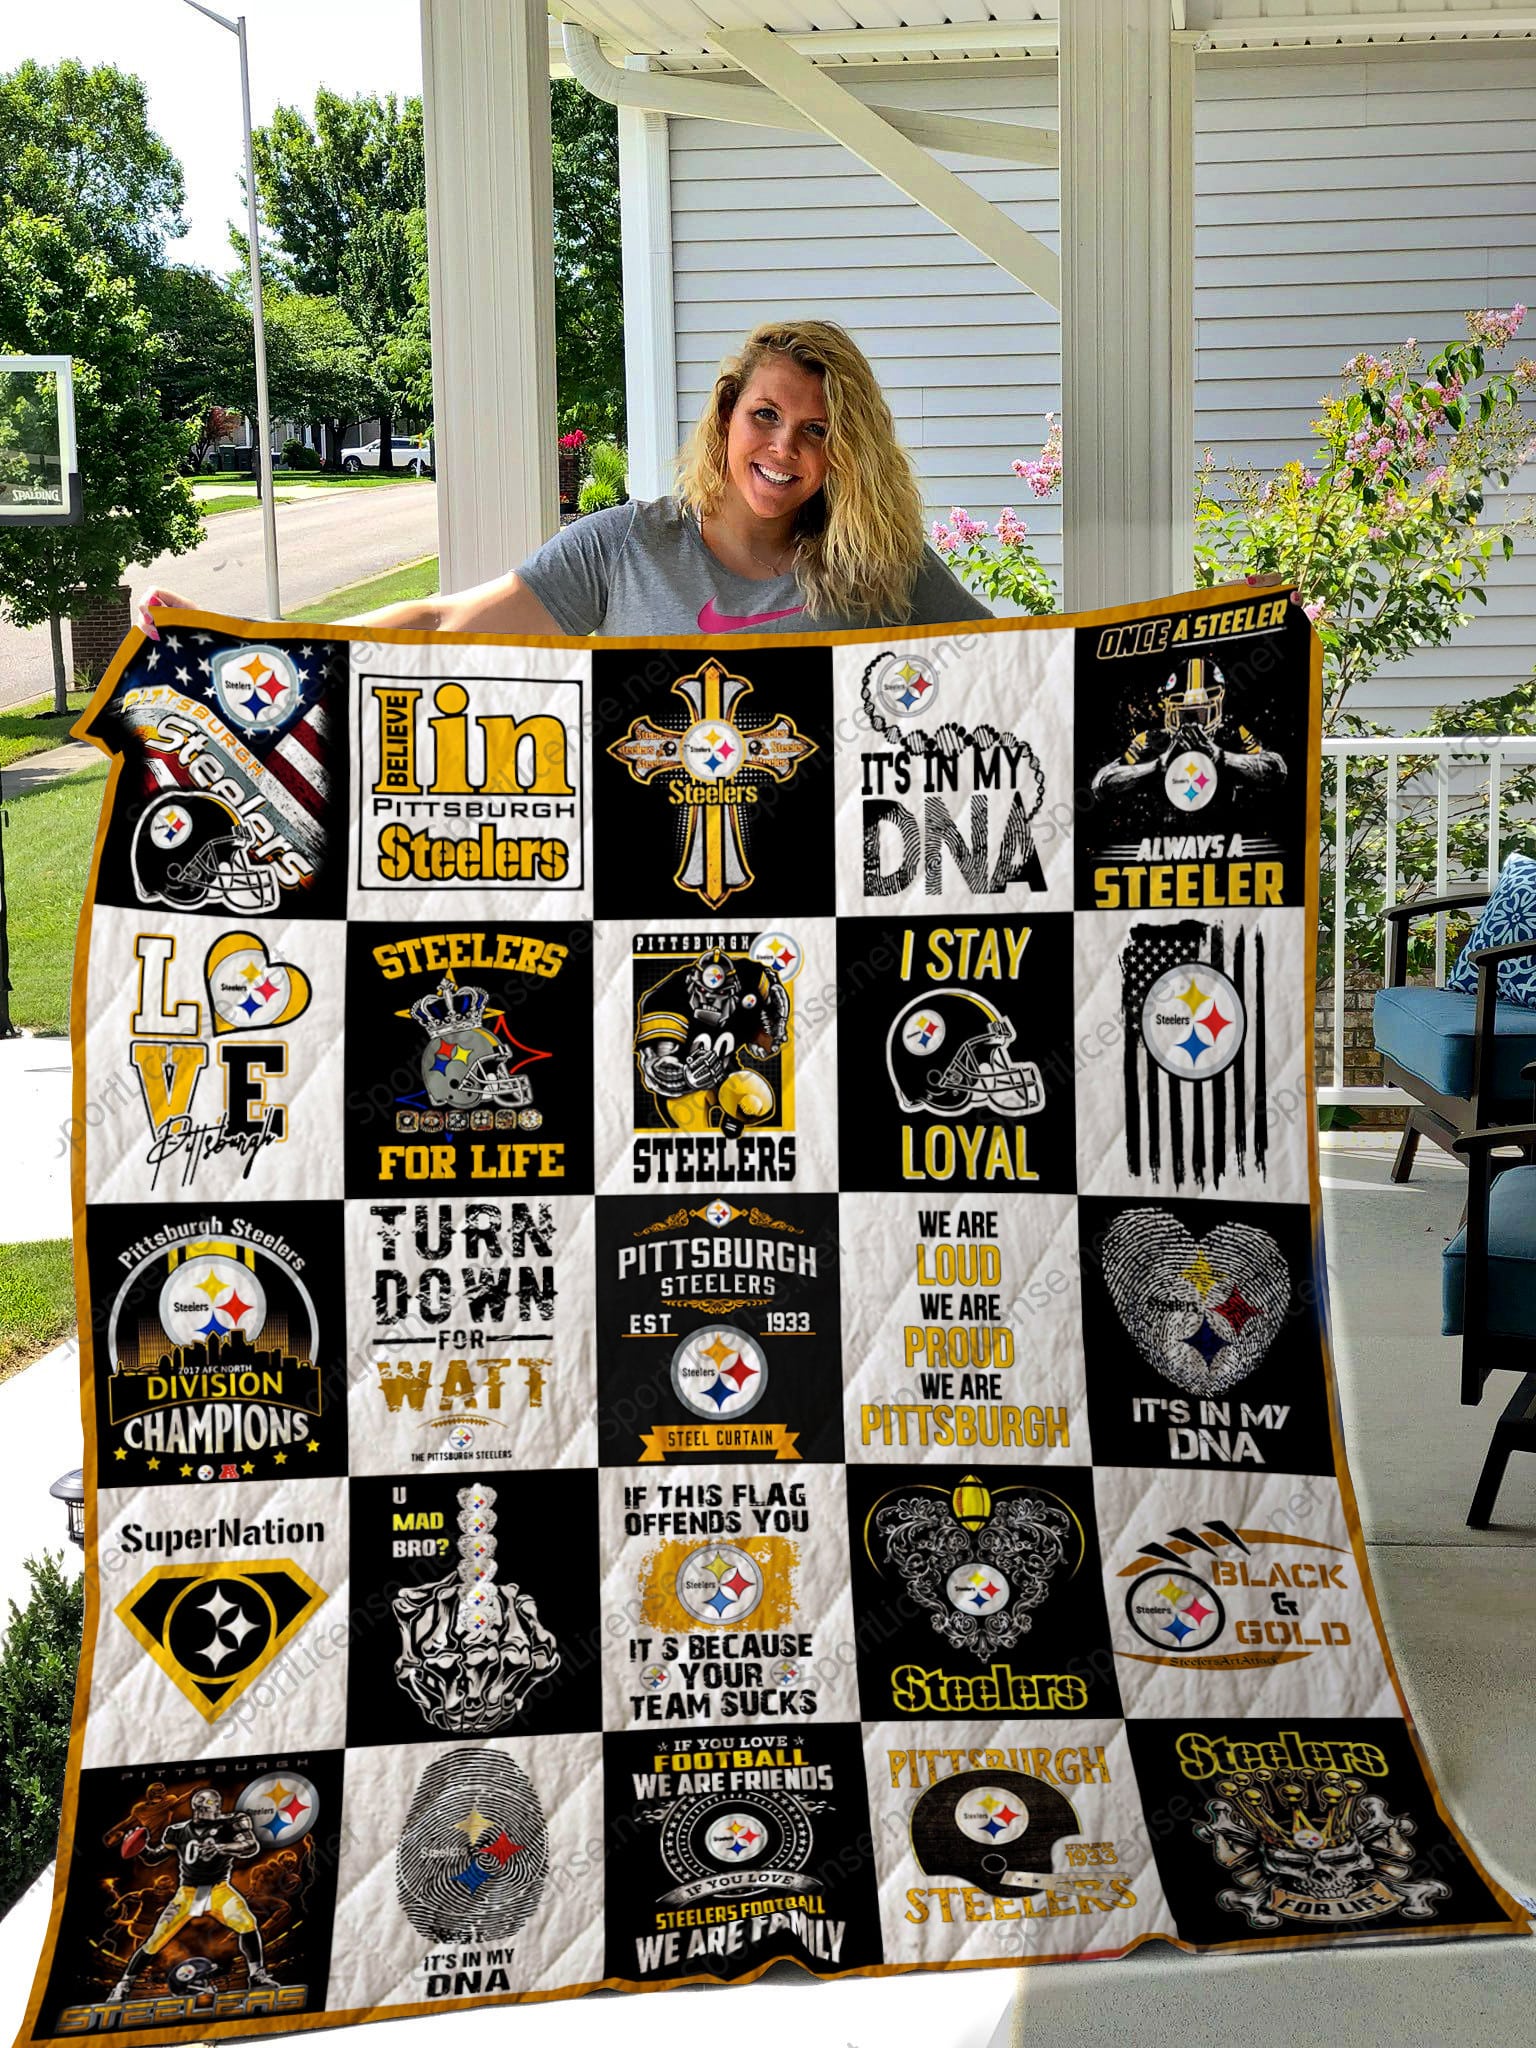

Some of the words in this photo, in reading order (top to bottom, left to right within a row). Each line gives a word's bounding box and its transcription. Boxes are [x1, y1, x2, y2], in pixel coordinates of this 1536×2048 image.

[12, 489, 61, 503] SPALDING
[1096, 618, 1171, 660] ONCE
[1172, 616, 1188, 642] A
[1194, 598, 1289, 639] STEELER
[223, 679, 253, 691] Steelers
[121, 685, 265, 778] PITTSBURGH
[386, 695, 408, 787] BELIEVE
[427, 682, 576, 796] in
[924, 749, 958, 793] IN
[973, 745, 1024, 791] MY
[145, 714, 315, 888] Steelers
[668, 776, 758, 805] Steelers
[373, 797, 575, 818] PITTSBURGH
[378, 822, 569, 881] Steelers
[862, 791, 1048, 897] DNA
[1136, 835, 1226, 861] ALWAYS
[1225, 833, 1245, 858] A
[1094, 861, 1284, 908] STEELER
[372, 932, 569, 980] STEELERS
[636, 935, 750, 951] PITTSBURGH
[900, 929, 915, 981] I
[926, 926, 1032, 981] STAY
[221, 983, 248, 992] Steelers
[1156, 1013, 1191, 1026] Steelers
[378, 1145, 457, 1180] FOR
[471, 1143, 566, 1179] LIFE
[633, 1136, 797, 1184] STEELERS
[902, 1124, 1039, 1180] LOYAL
[370, 1202, 557, 1261] TURN
[918, 1211, 951, 1238] WE
[956, 1211, 998, 1238] ARE
[117, 1215, 224, 1270] Pittsburgh
[230, 1217, 307, 1272] Steelers
[618, 1236, 818, 1280] PITTSBURGH
[916, 1244, 1002, 1286] LOUD
[372, 1265, 558, 1325] DOWN
[660, 1273, 776, 1297] STEELERS
[173, 1302, 210, 1313] Steelers
[920, 1293, 953, 1320] WE
[959, 1294, 1001, 1320] ARE
[630, 1313, 672, 1334] EST
[766, 1311, 811, 1332] 1933
[438, 1329, 485, 1350] FOR
[904, 1326, 1015, 1368] PROUD
[178, 1366, 200, 1375] 2017
[202, 1365, 219, 1374] AFC
[221, 1364, 253, 1373] NORTH
[682, 1367, 716, 1377] Steelers
[147, 1371, 283, 1401] DIVISION
[377, 1358, 552, 1412] WATT
[920, 1373, 954, 1400] WE
[960, 1374, 1002, 1400] ARE
[860, 1404, 1070, 1448] PITTSBURGH
[1132, 1397, 1192, 1424] IT'S
[1200, 1400, 1231, 1427] IN
[1240, 1402, 1291, 1430] MY
[124, 1403, 310, 1455] CHAMPIONS
[668, 1431, 709, 1447] STEEL
[716, 1429, 774, 1446] CURTAIN
[411, 1453, 425, 1462] THE
[427, 1451, 474, 1462] PITTSBURGH
[476, 1450, 513, 1460] STEELERS
[1168, 1427, 1266, 1464] DNA
[393, 1487, 407, 1505] U
[624, 1486, 647, 1510] IF
[658, 1484, 723, 1508] THIS
[732, 1482, 807, 1507] FLAG
[393, 1512, 444, 1533] MAD
[624, 1511, 742, 1536] OFFENDS
[752, 1509, 809, 1534] YOU
[121, 1518, 325, 1557] SuperNation
[393, 1538, 449, 1558] BRO?
[685, 1581, 717, 1590] Steelers
[1210, 1560, 1349, 1589] BLACK
[1136, 1605, 1172, 1614] Steelers
[1270, 1592, 1299, 1616] &
[688, 1633, 813, 1660] BECAUSE
[1235, 1620, 1351, 1646] GOLD
[679, 1662, 764, 1690] YOUR
[891, 1664, 1088, 1712] Steelers
[629, 1691, 711, 1721] TEAM
[720, 1688, 818, 1717] SUCKS
[674, 1739, 693, 1752] IF
[697, 1737, 735, 1750] YOU
[739, 1736, 788, 1748] LOVE
[1175, 1731, 1390, 1780] Steelers
[120, 1758, 310, 1781] PITTSBURGH
[653, 1748, 809, 1773] FOOTBALL
[887, 1746, 1112, 1788] PITTSBURGH
[632, 1773, 672, 1800] WE
[677, 1772, 725, 1796] ARE
[730, 1764, 834, 1792] FRIENDS
[1064, 1849, 1119, 1867] 1933
[685, 1884, 703, 1898] IF
[707, 1874, 744, 1890] YOU
[748, 1873, 795, 1887] LOVE
[656, 1904, 738, 1930] STEELERS
[740, 1895, 826, 1918] FOOTBALL
[905, 1878, 1138, 1924] STEELERS
[1278, 1896, 1334, 1917] FOR
[1336, 1891, 1393, 1915] LIFE
[635, 1932, 682, 1974] WE
[686, 1919, 746, 1958] ARE
[751, 1909, 847, 1964] FAMILY
[423, 1953, 457, 1972] IT'S
[462, 1952, 482, 1968] IN
[487, 1948, 515, 1966] MY
[426, 1968, 512, 1998] DNA
[55, 1985, 309, 2034] STEELERS
